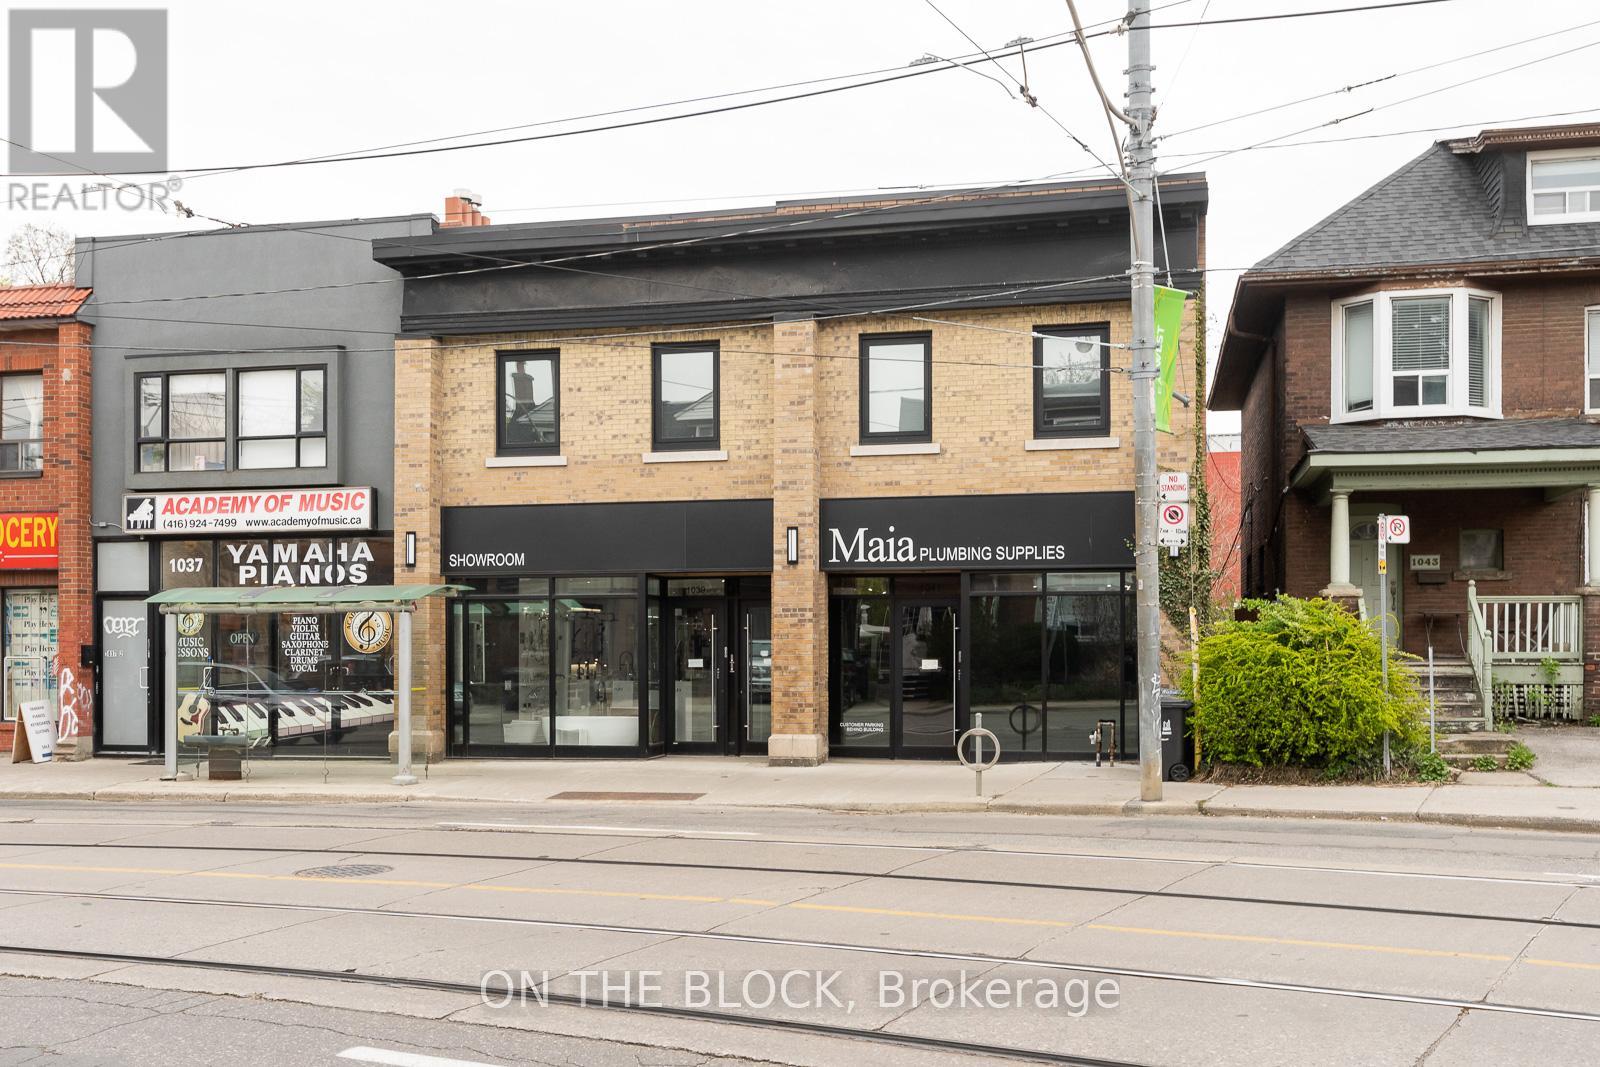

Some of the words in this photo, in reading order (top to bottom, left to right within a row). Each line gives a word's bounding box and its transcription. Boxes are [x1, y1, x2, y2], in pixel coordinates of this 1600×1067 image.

[162, 495, 261, 516] ACADEMY
[263, 493, 292, 513] OF
[299, 491, 366, 512] MUSIC
[245, 516, 362, 528] www.academyofmusic.ca
[828, 525, 917, 563] Maia
[919, 546, 992, 562] PLUMBING
[995, 545, 1065, 560] SUPPLIES
[226, 542, 374, 564] YAMAHA
[449, 552, 525, 567] SHOWROOM
[1412, 558, 1439, 566] 1043
[169, 557, 203, 573] 1037
[238, 564, 368, 585] PIANOS
[24, 596, 37, 605] Play
[292, 616, 318, 624] PIANO
[24, 621, 37, 629] Play
[291, 624, 319, 632] VIOLIN
[230, 633, 254, 644] OPEN
[290, 632, 320, 640] GUITAR
[375, 627, 391, 647] MUSIC
[281, 640, 329, 648] SAXOPHONE
[284, 648, 325, 656] CLARINET
[290, 656, 319, 664] DRUMS
[291, 664, 318, 672] VOCAL
